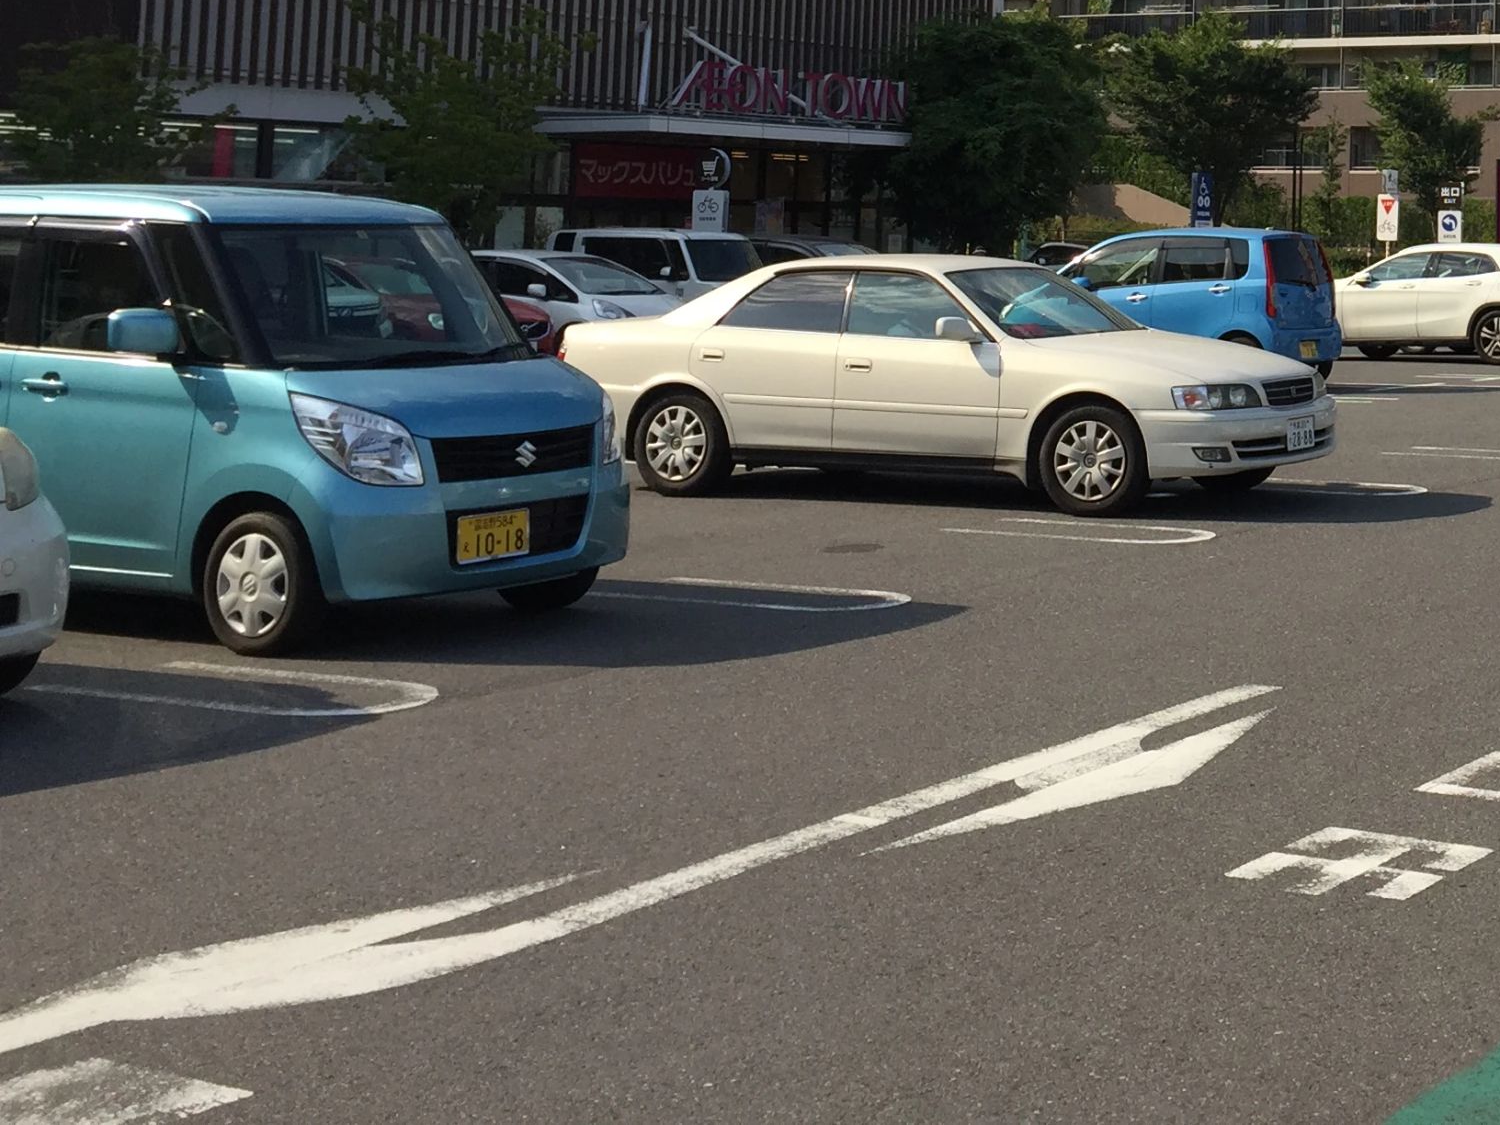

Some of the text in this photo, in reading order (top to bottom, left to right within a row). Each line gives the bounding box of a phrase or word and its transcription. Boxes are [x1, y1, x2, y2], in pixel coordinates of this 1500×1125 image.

[803, 70, 909, 123] TOWN
[579, 158, 697, 187] マックスバリュ
[1440, 186, 1460, 197] 出口
[476, 528, 524, 557] 10-18
